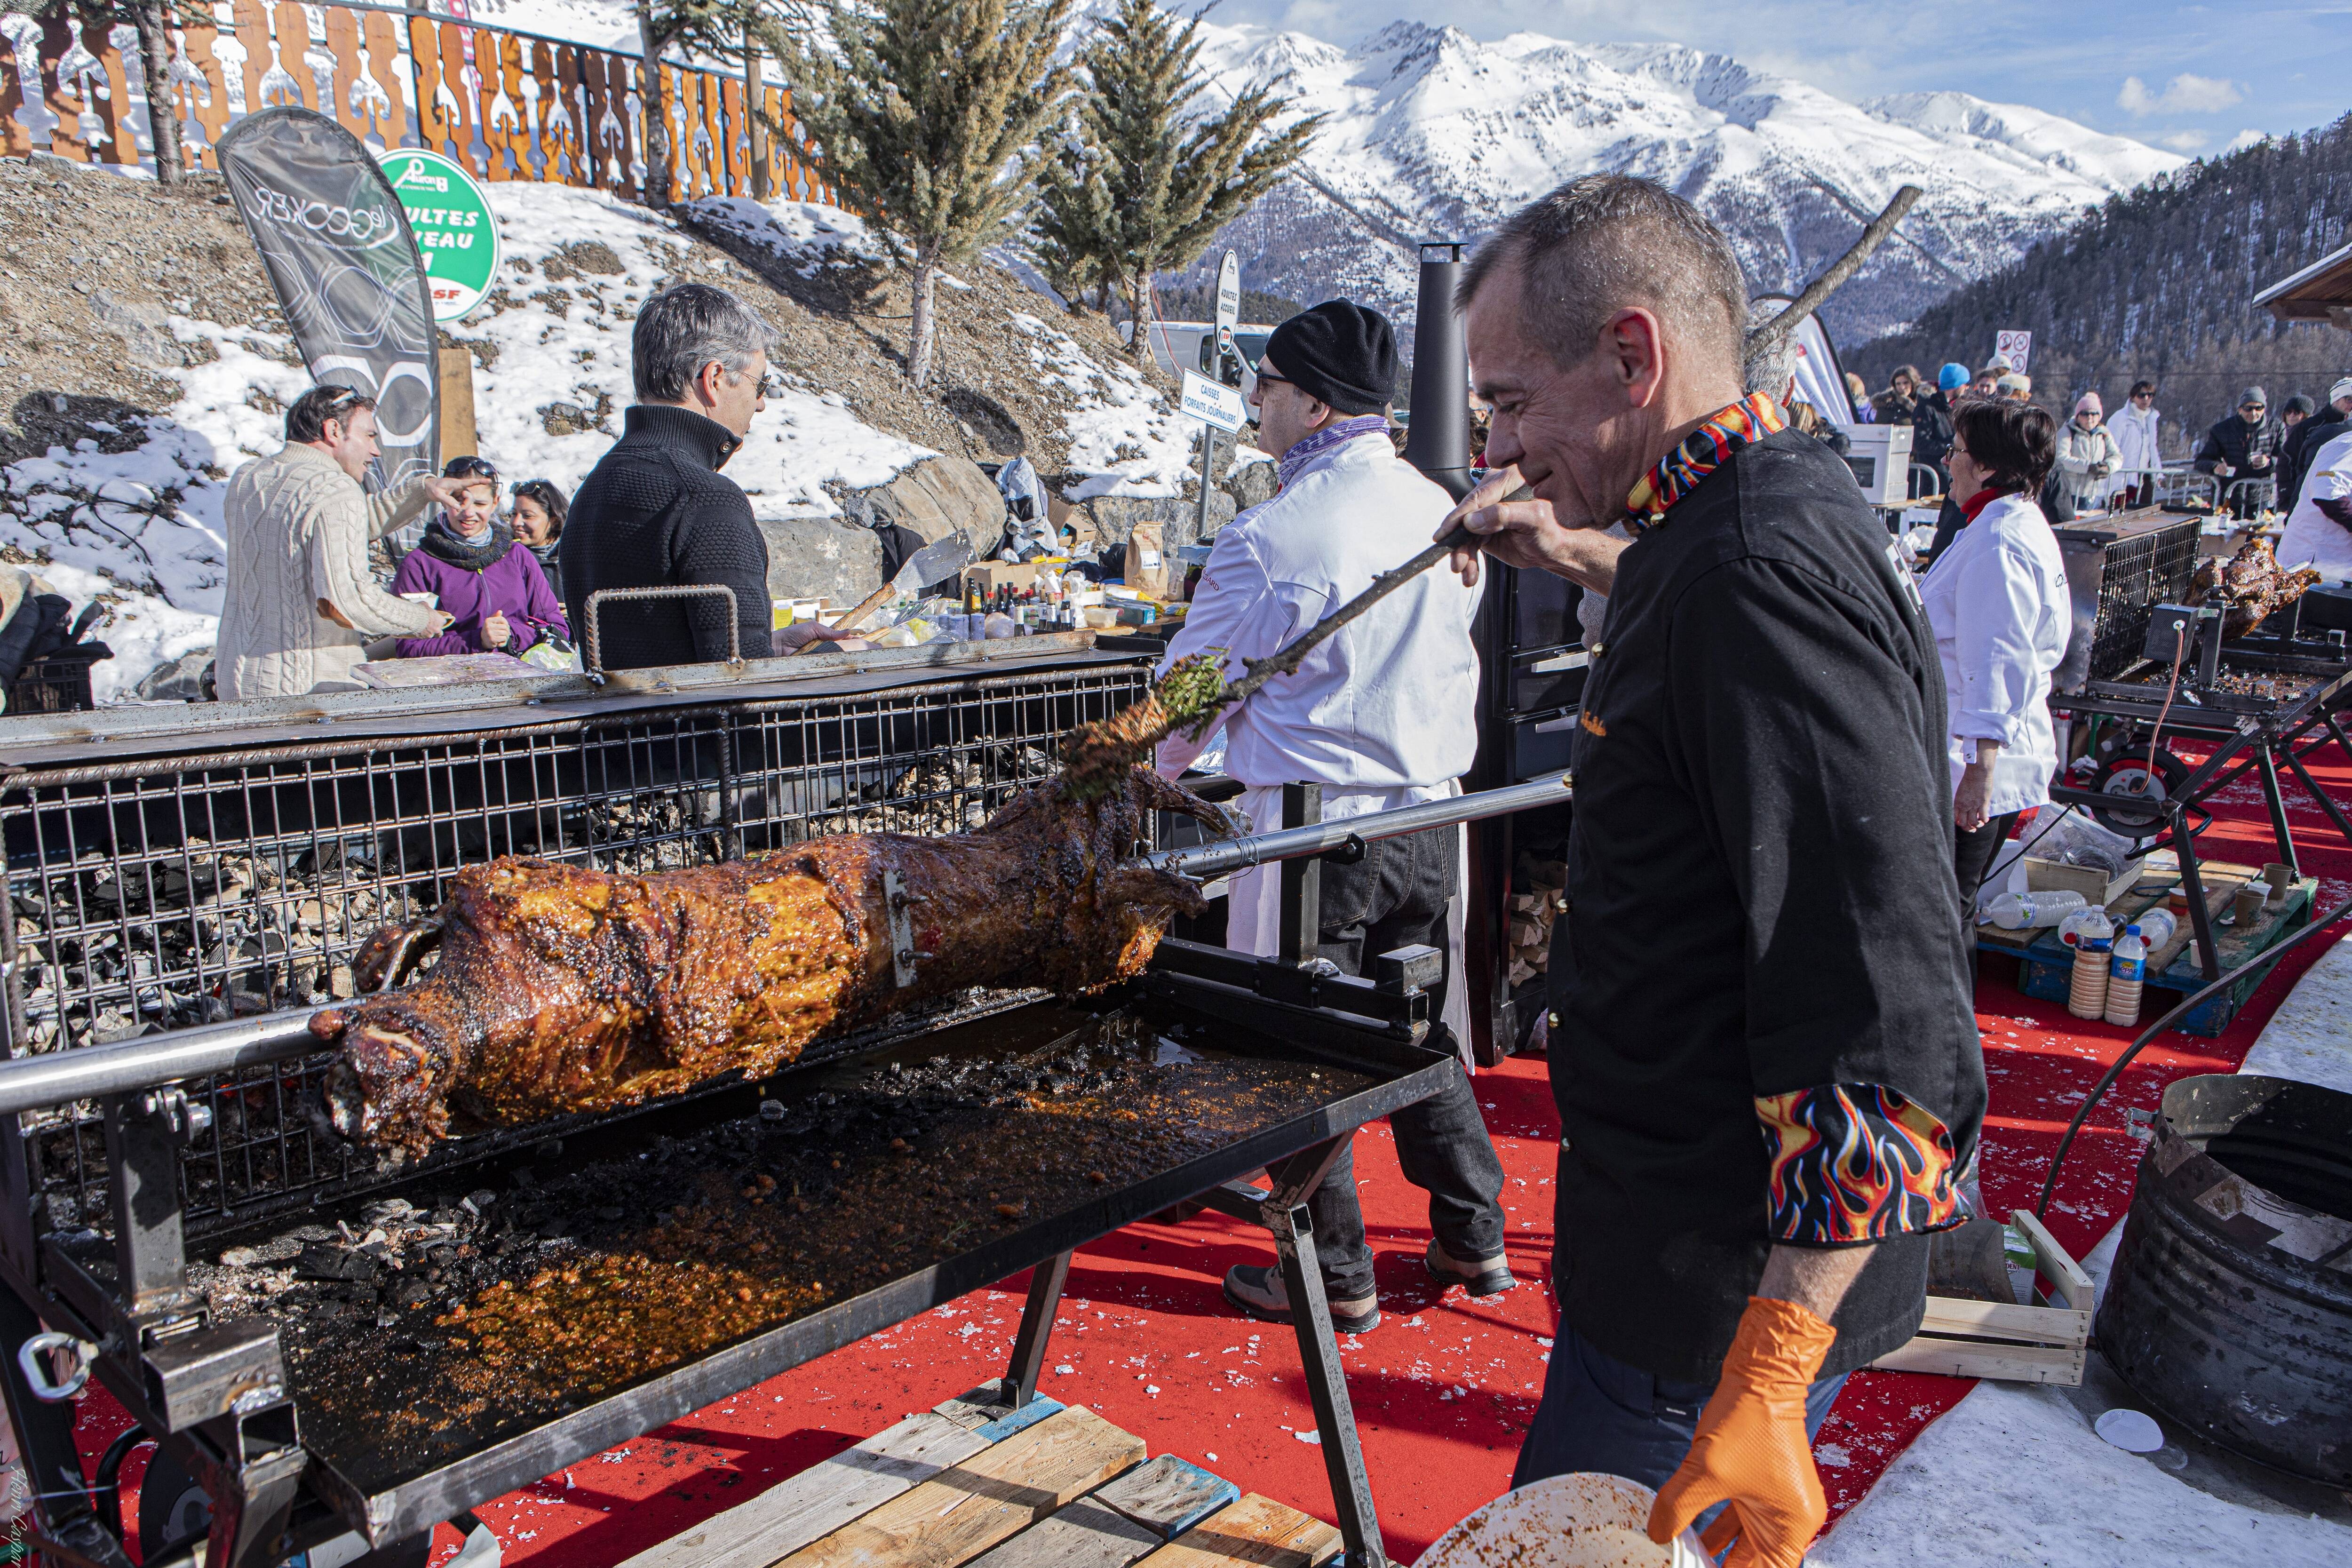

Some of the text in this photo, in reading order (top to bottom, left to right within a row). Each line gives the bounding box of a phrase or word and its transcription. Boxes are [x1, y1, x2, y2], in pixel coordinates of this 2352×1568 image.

[429, 289, 461, 299] SF
[1221, 288, 1237, 302] ADULTES
[1221, 302, 1235, 315] ACCUEIL
[1201, 385, 1219, 400] CAISSES
[1184, 396, 1236, 424] FORFAITS JOURNALIERS
